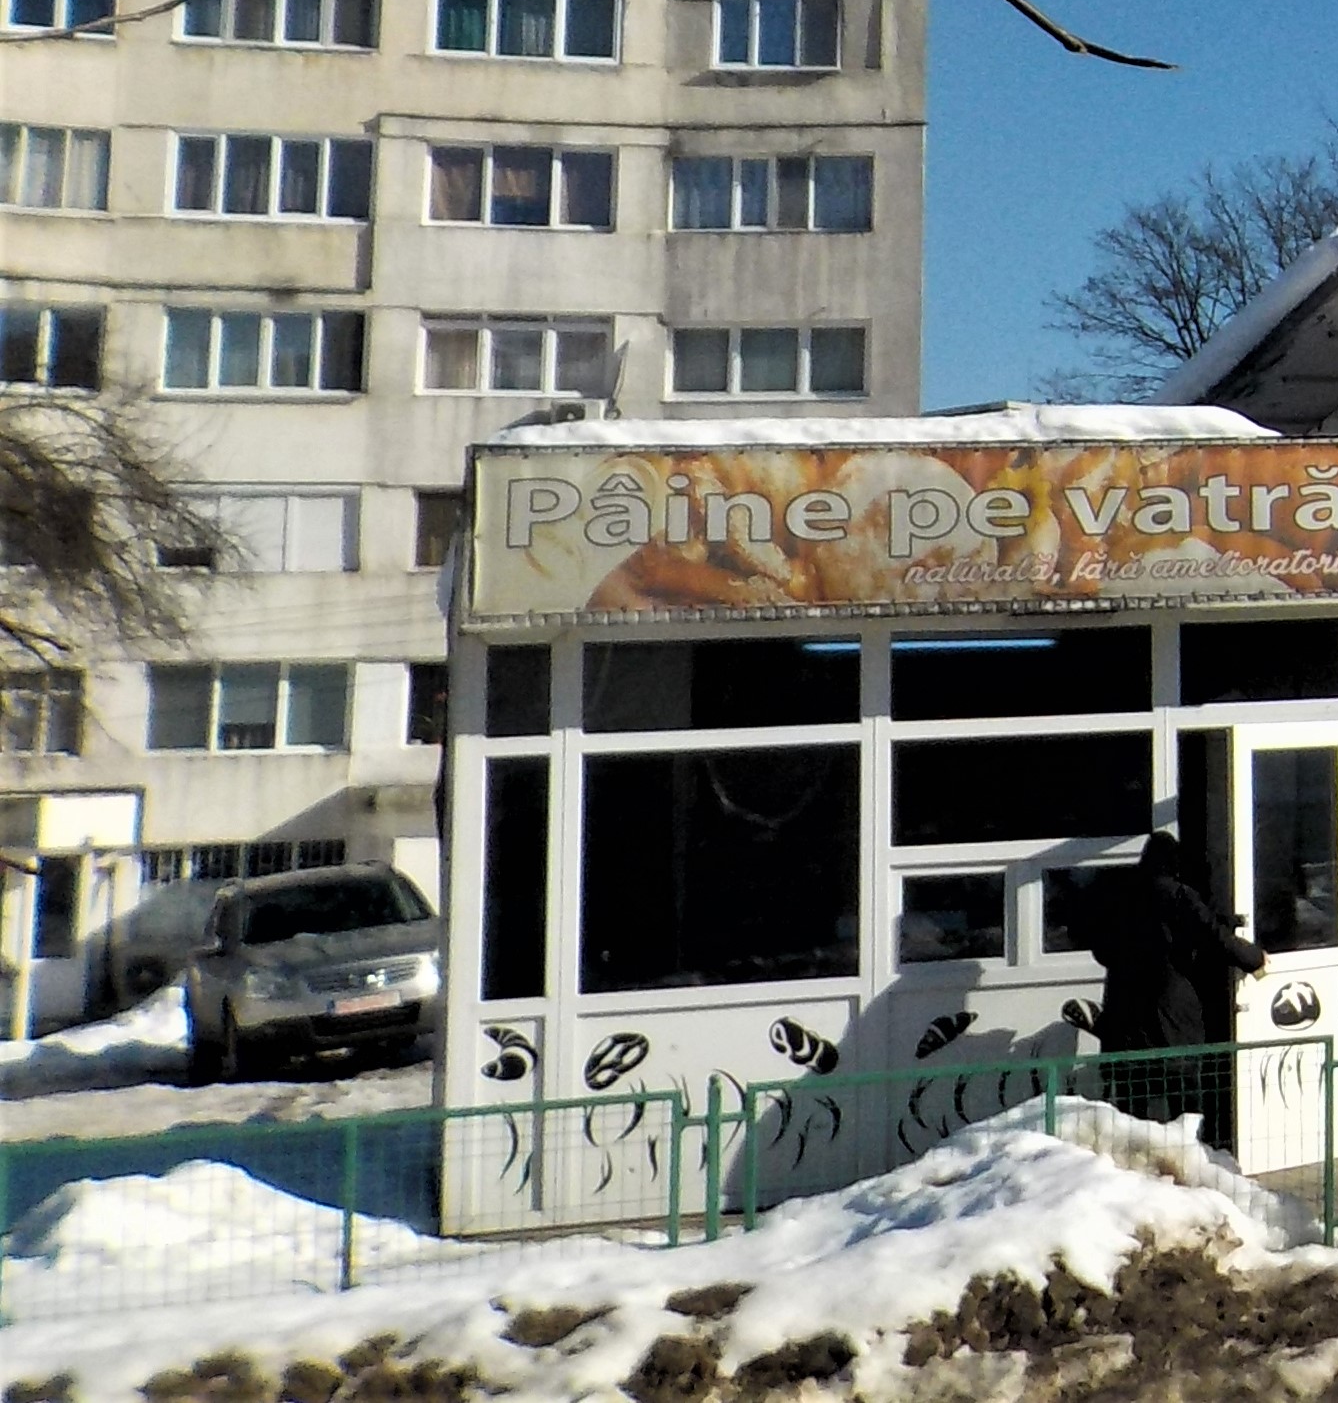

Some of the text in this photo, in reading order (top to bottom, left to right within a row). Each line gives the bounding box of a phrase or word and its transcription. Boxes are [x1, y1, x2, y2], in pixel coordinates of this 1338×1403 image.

[504, 472, 853, 549] Pâine
[888, 486, 1032, 559] pe
[903, 550, 1060, 585] naturală,
[1069, 548, 1150, 583] fără
